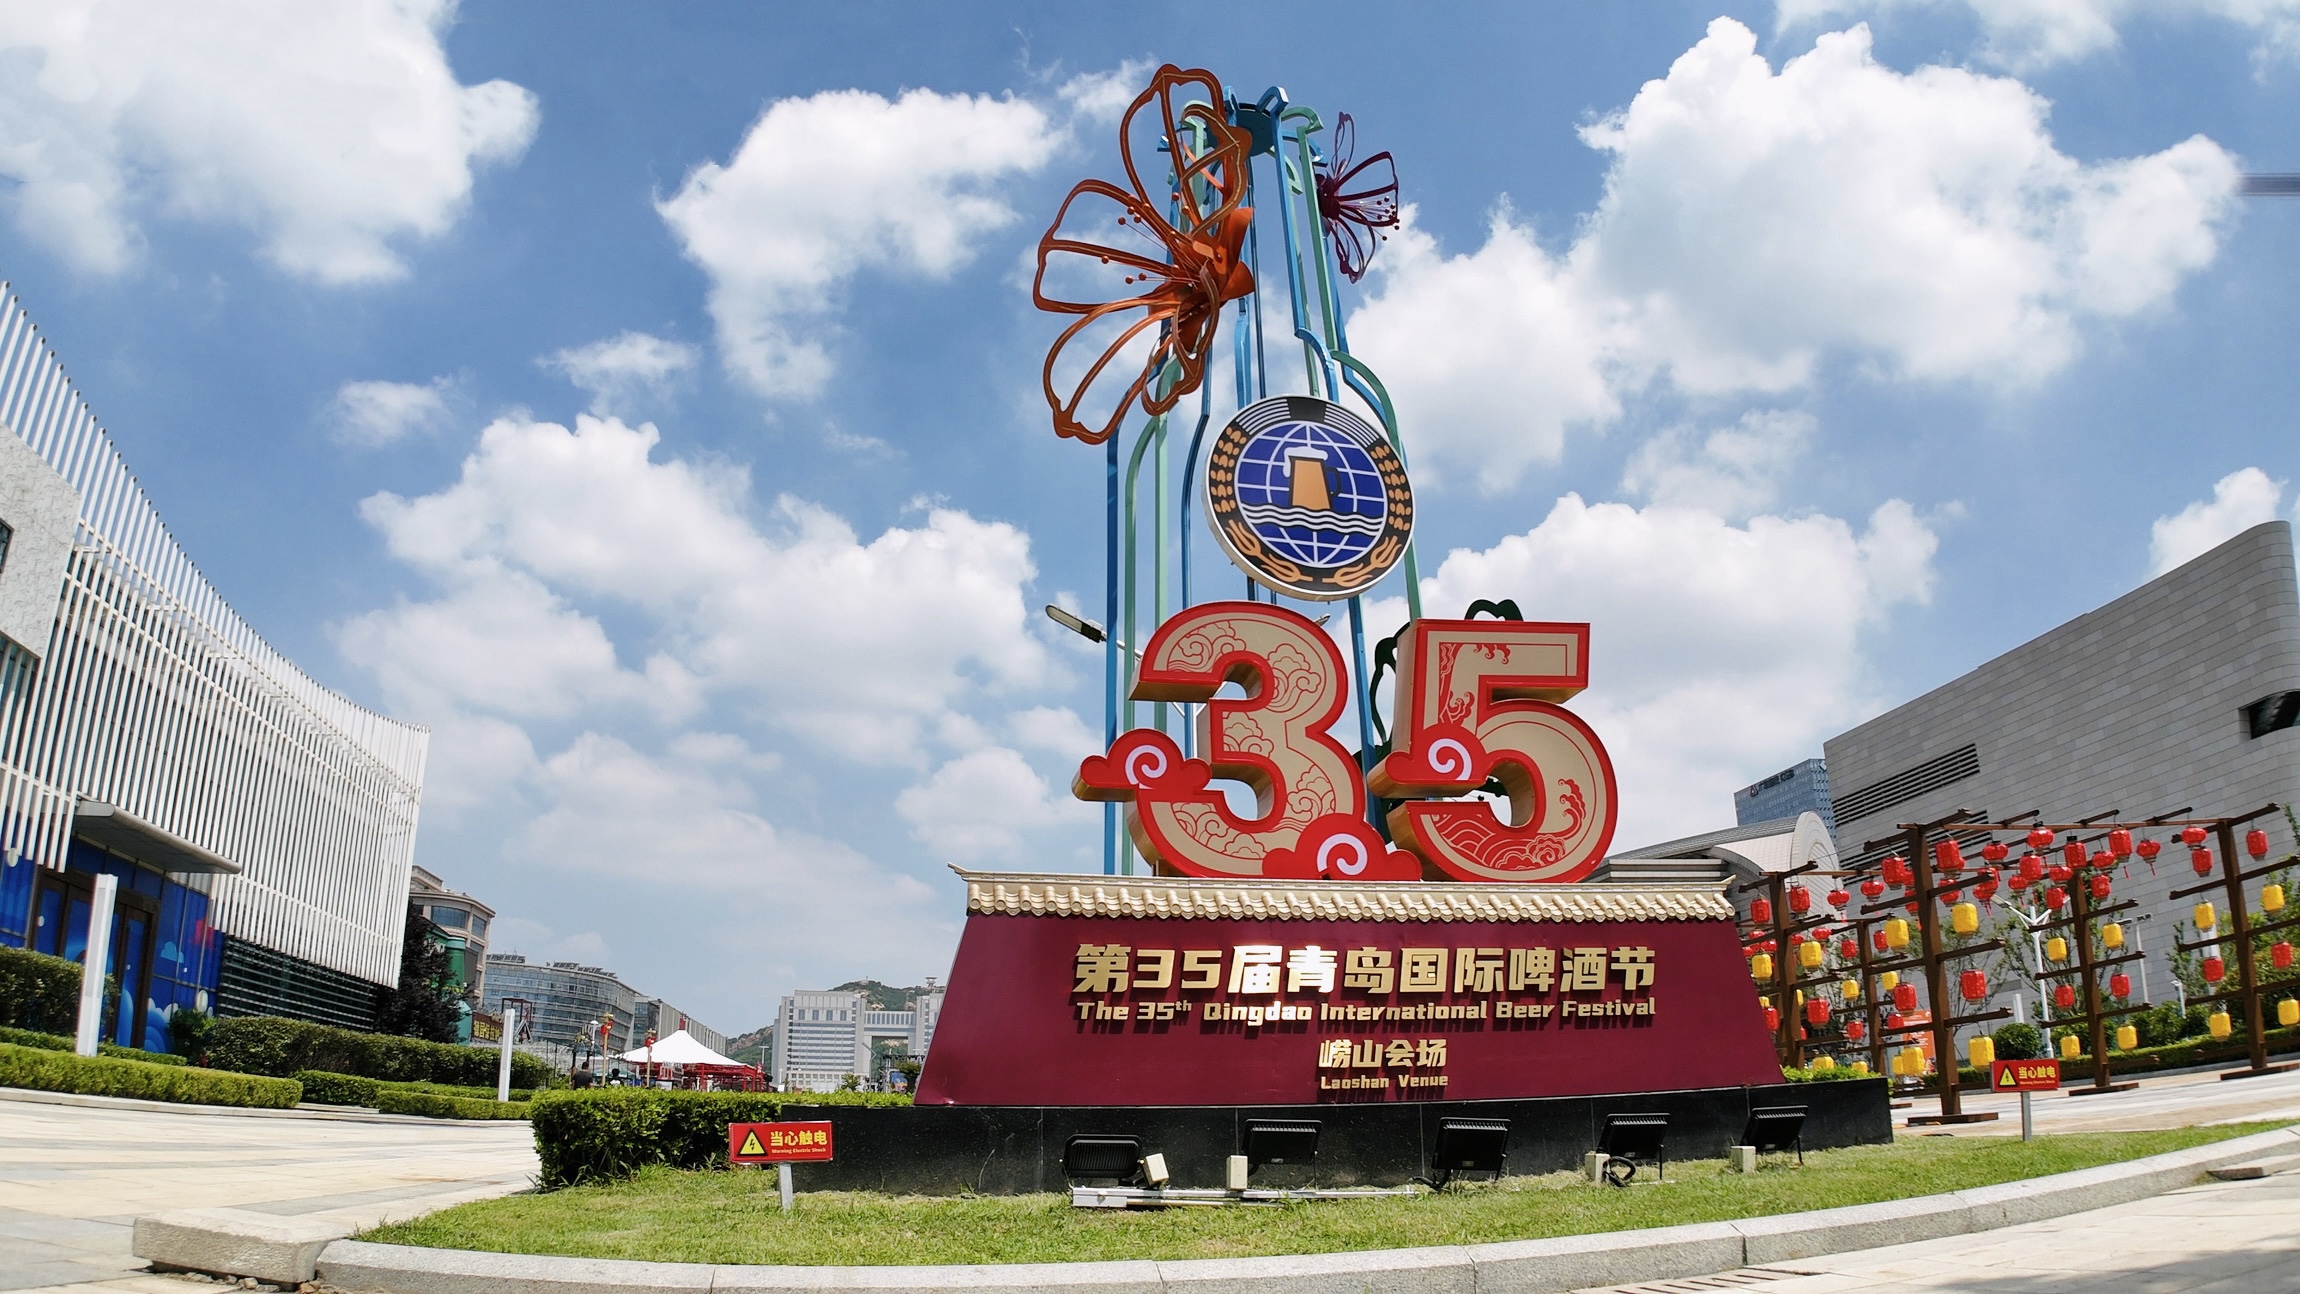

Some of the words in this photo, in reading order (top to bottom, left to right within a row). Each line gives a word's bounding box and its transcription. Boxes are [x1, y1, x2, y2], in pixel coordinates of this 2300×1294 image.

[1128, 600, 1618, 882] 35
[1072, 943, 1656, 994] 第35届青岛国际啤酒节
[1077, 1001, 1128, 1020] The
[1136, 999, 1192, 1020] 35th
[1203, 1000, 1312, 1026] Qingdao
[1320, 1000, 1487, 1021] International
[1496, 1001, 1555, 1019] Beer
[1562, 997, 1656, 1017] Festival
[1318, 1038, 1448, 1068] 崂山会场
[1320, 1074, 1390, 1090] Laoshan
[1398, 1074, 1449, 1089] Venue
[770, 1130, 828, 1147] 当心触电
